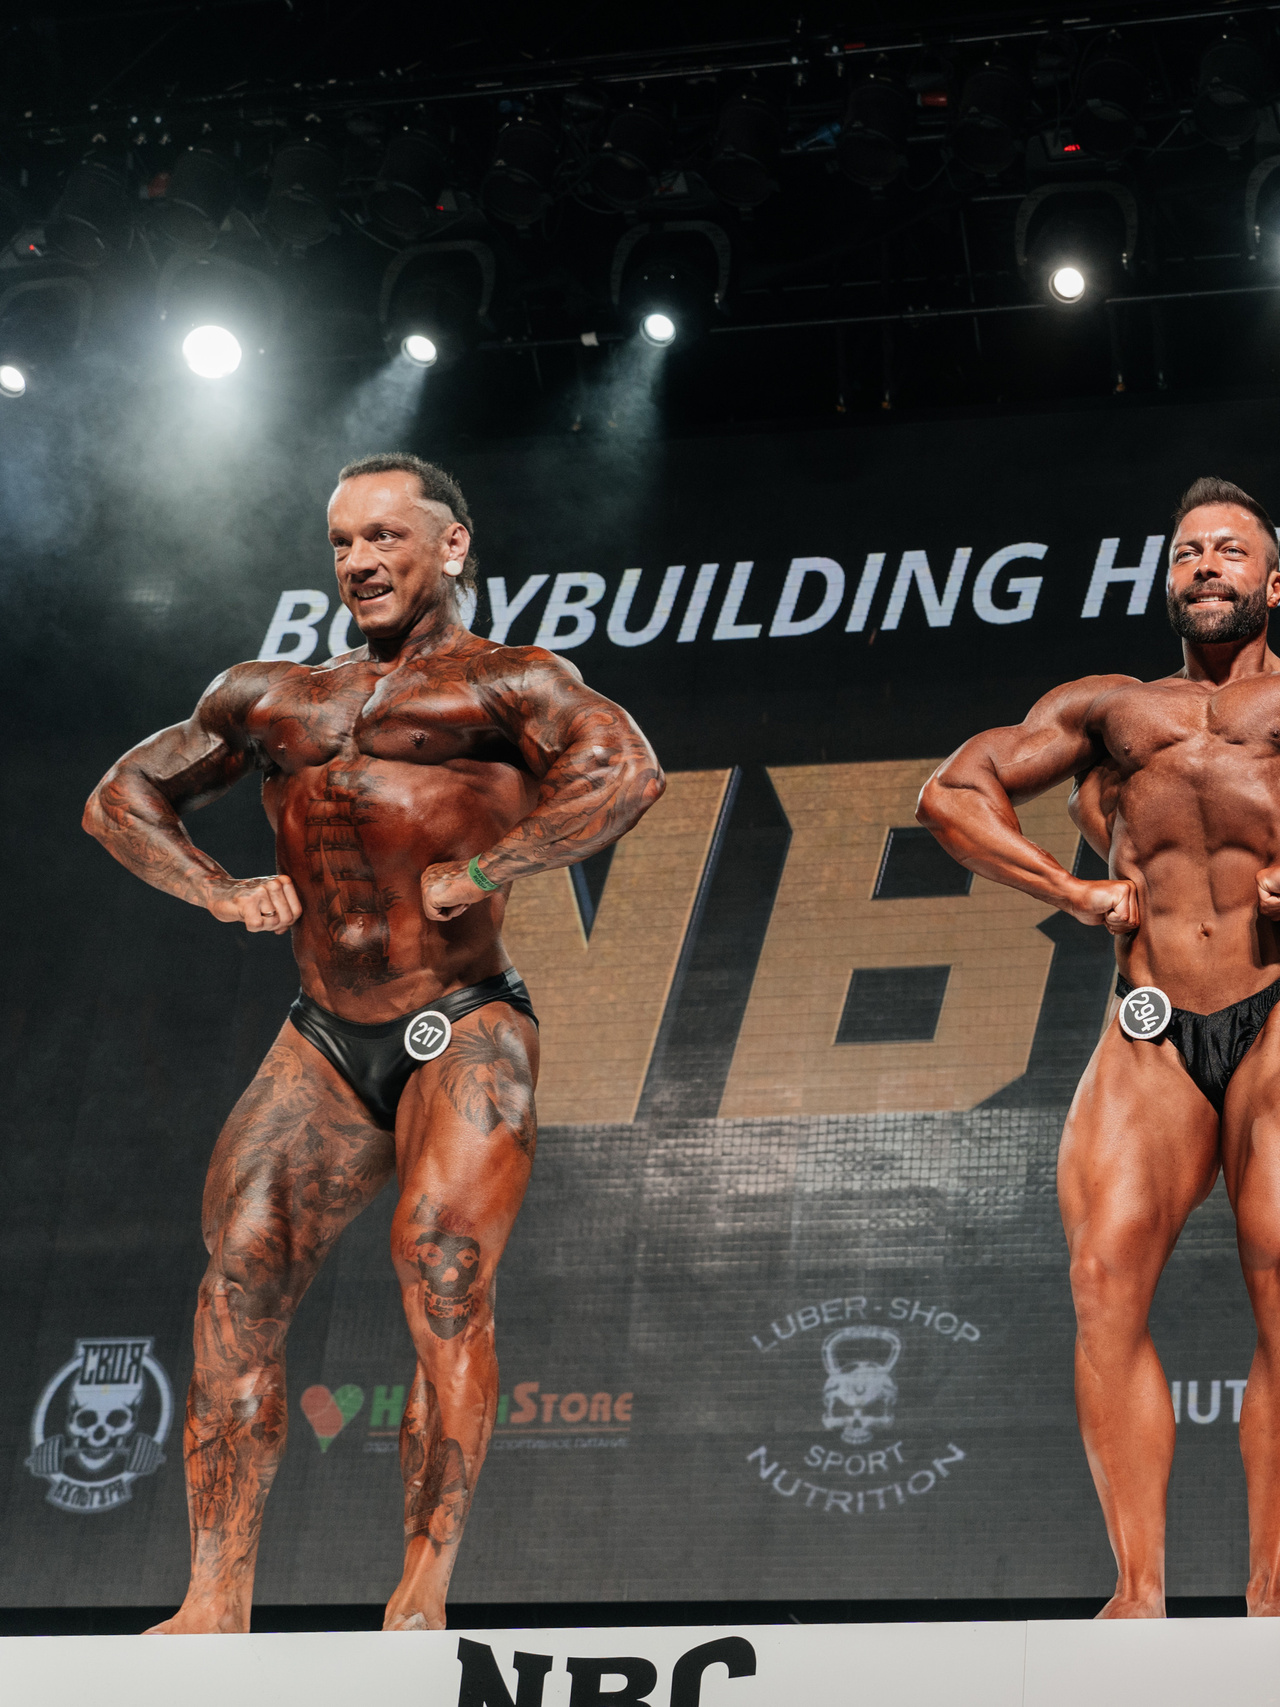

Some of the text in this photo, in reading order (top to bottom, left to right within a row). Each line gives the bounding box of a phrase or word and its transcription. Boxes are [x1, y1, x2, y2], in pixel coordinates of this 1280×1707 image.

[258, 542, 1049, 664] BYBUILDING
[411, 1021, 444, 1048] 217
[1128, 993, 1160, 1032] 294
[747, 1443, 967, 1514] NUTRITION
[803, 1440, 905, 1476] SPORT
[457, 1636, 757, 1707] NBC
